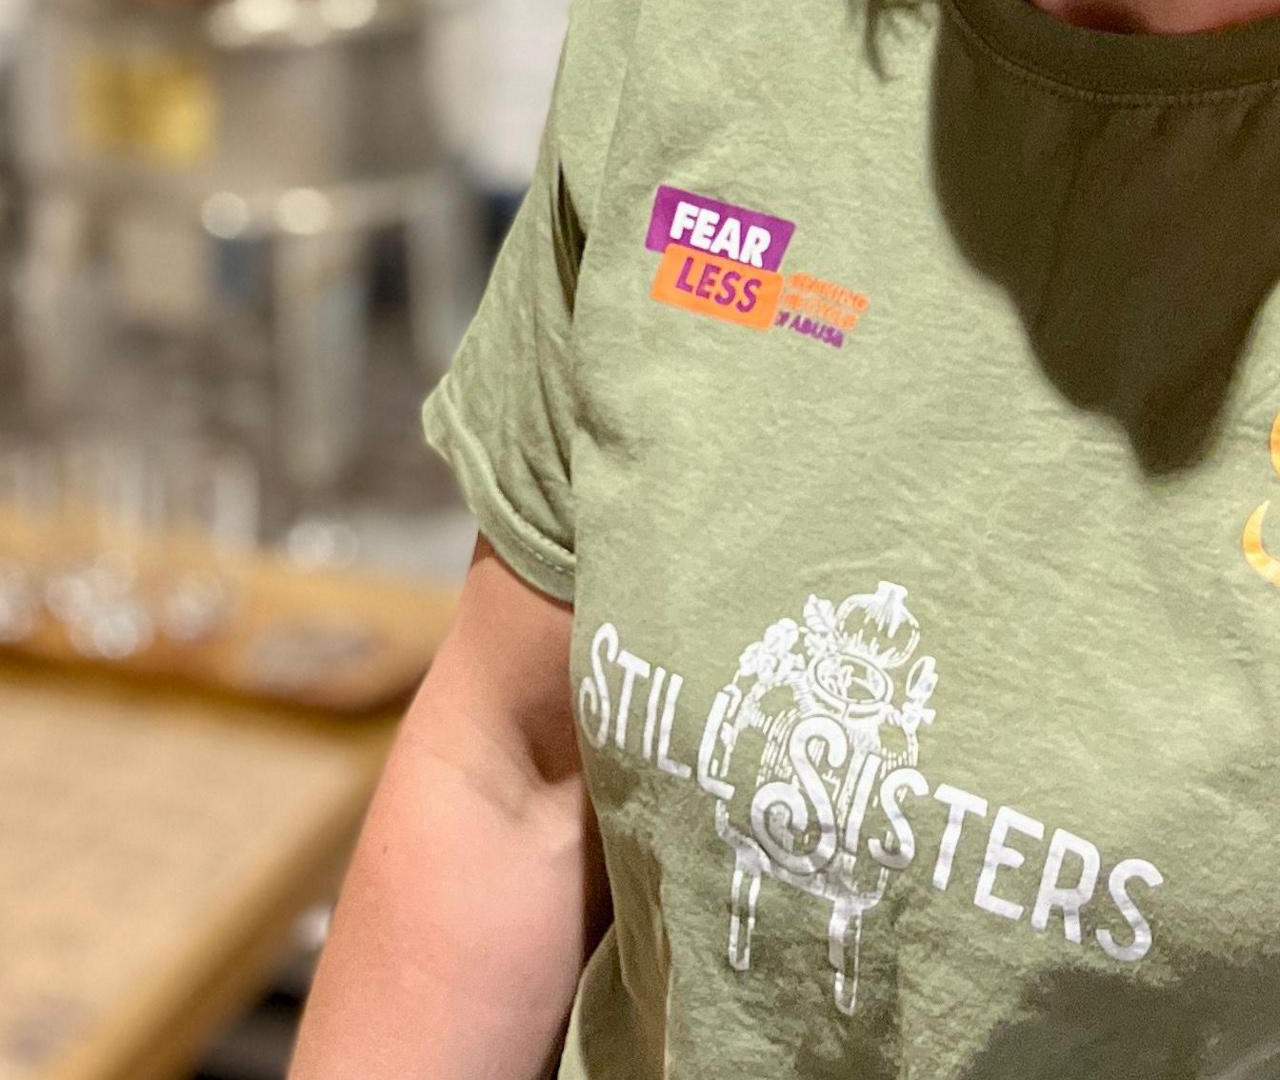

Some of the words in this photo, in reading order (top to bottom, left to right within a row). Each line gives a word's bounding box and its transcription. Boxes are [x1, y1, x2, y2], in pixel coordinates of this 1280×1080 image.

[669, 201, 772, 267] FEAR
[676, 257, 762, 313] LESS
[578, 622, 735, 800] STILL
[750, 716, 1164, 962] SISTERS
